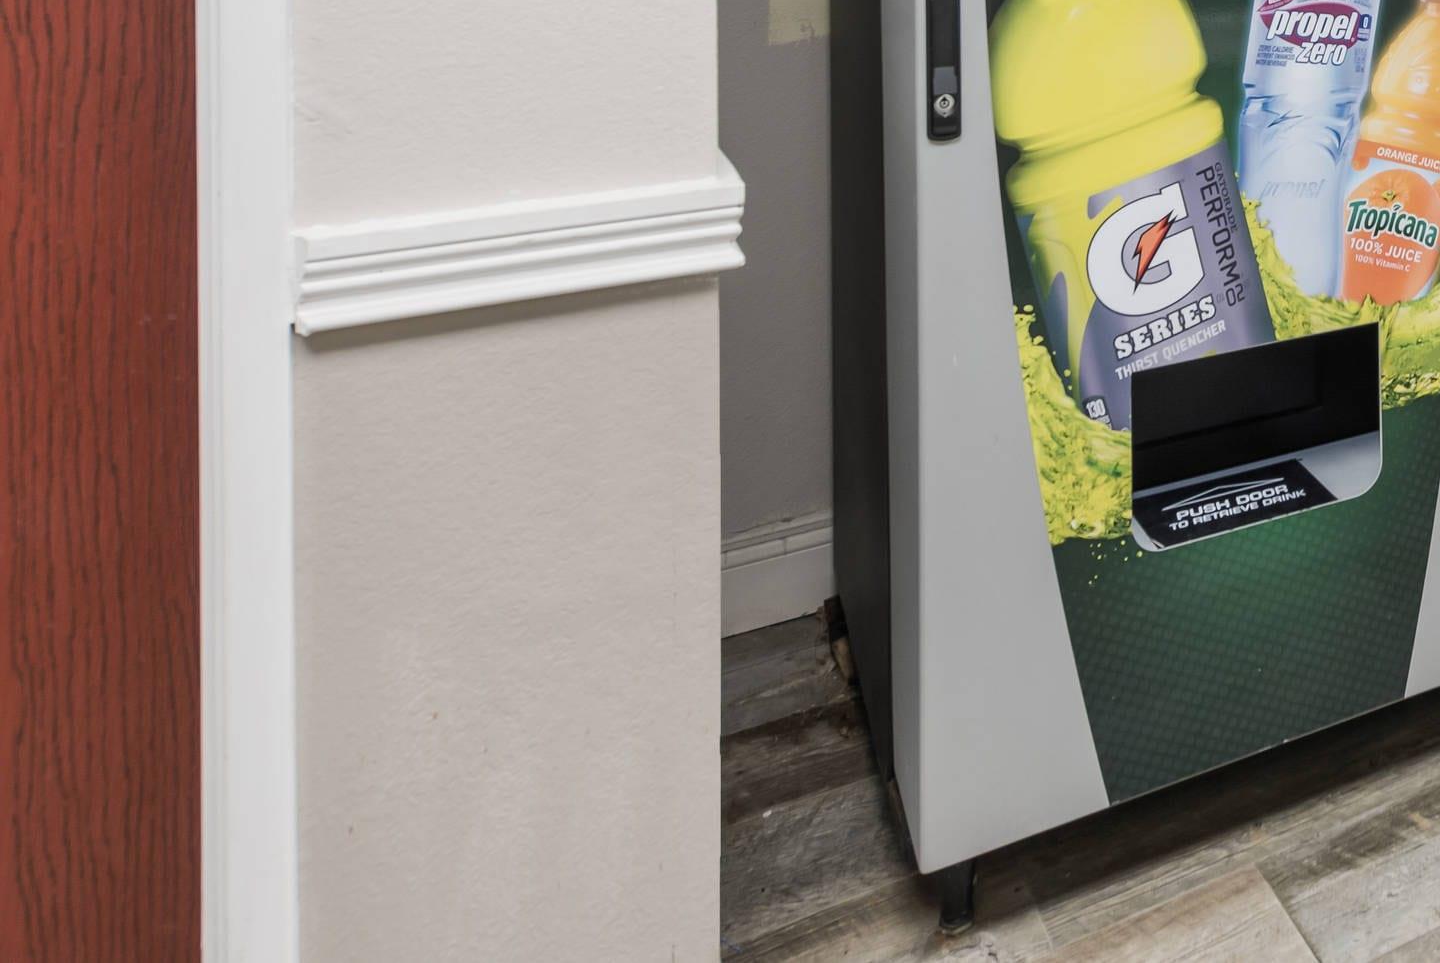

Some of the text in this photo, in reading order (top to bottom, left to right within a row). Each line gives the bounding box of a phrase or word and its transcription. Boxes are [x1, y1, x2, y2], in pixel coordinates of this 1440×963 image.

[1266, 9, 1359, 43] propel
[1295, 41, 1348, 66] zero
[1376, 146, 1418, 165] ORANGE
[1214, 161, 1238, 232] GATORADE
[1196, 164, 1244, 288] PERFORM
[1346, 200, 1439, 248] Tropicana
[1086, 181, 1206, 318] G
[1350, 238, 1423, 263] 100% JUICE
[1355, 253, 1411, 272] 100% Vitamin C
[1225, 283, 1246, 307] 02
[1112, 294, 1218, 361] SERIES
[1114, 319, 1227, 382] THIRST QUENCHER
[1168, 488, 1307, 532] TO RETRIEVE DRINK
[1176, 484, 1289, 522] PUSH DOOR
